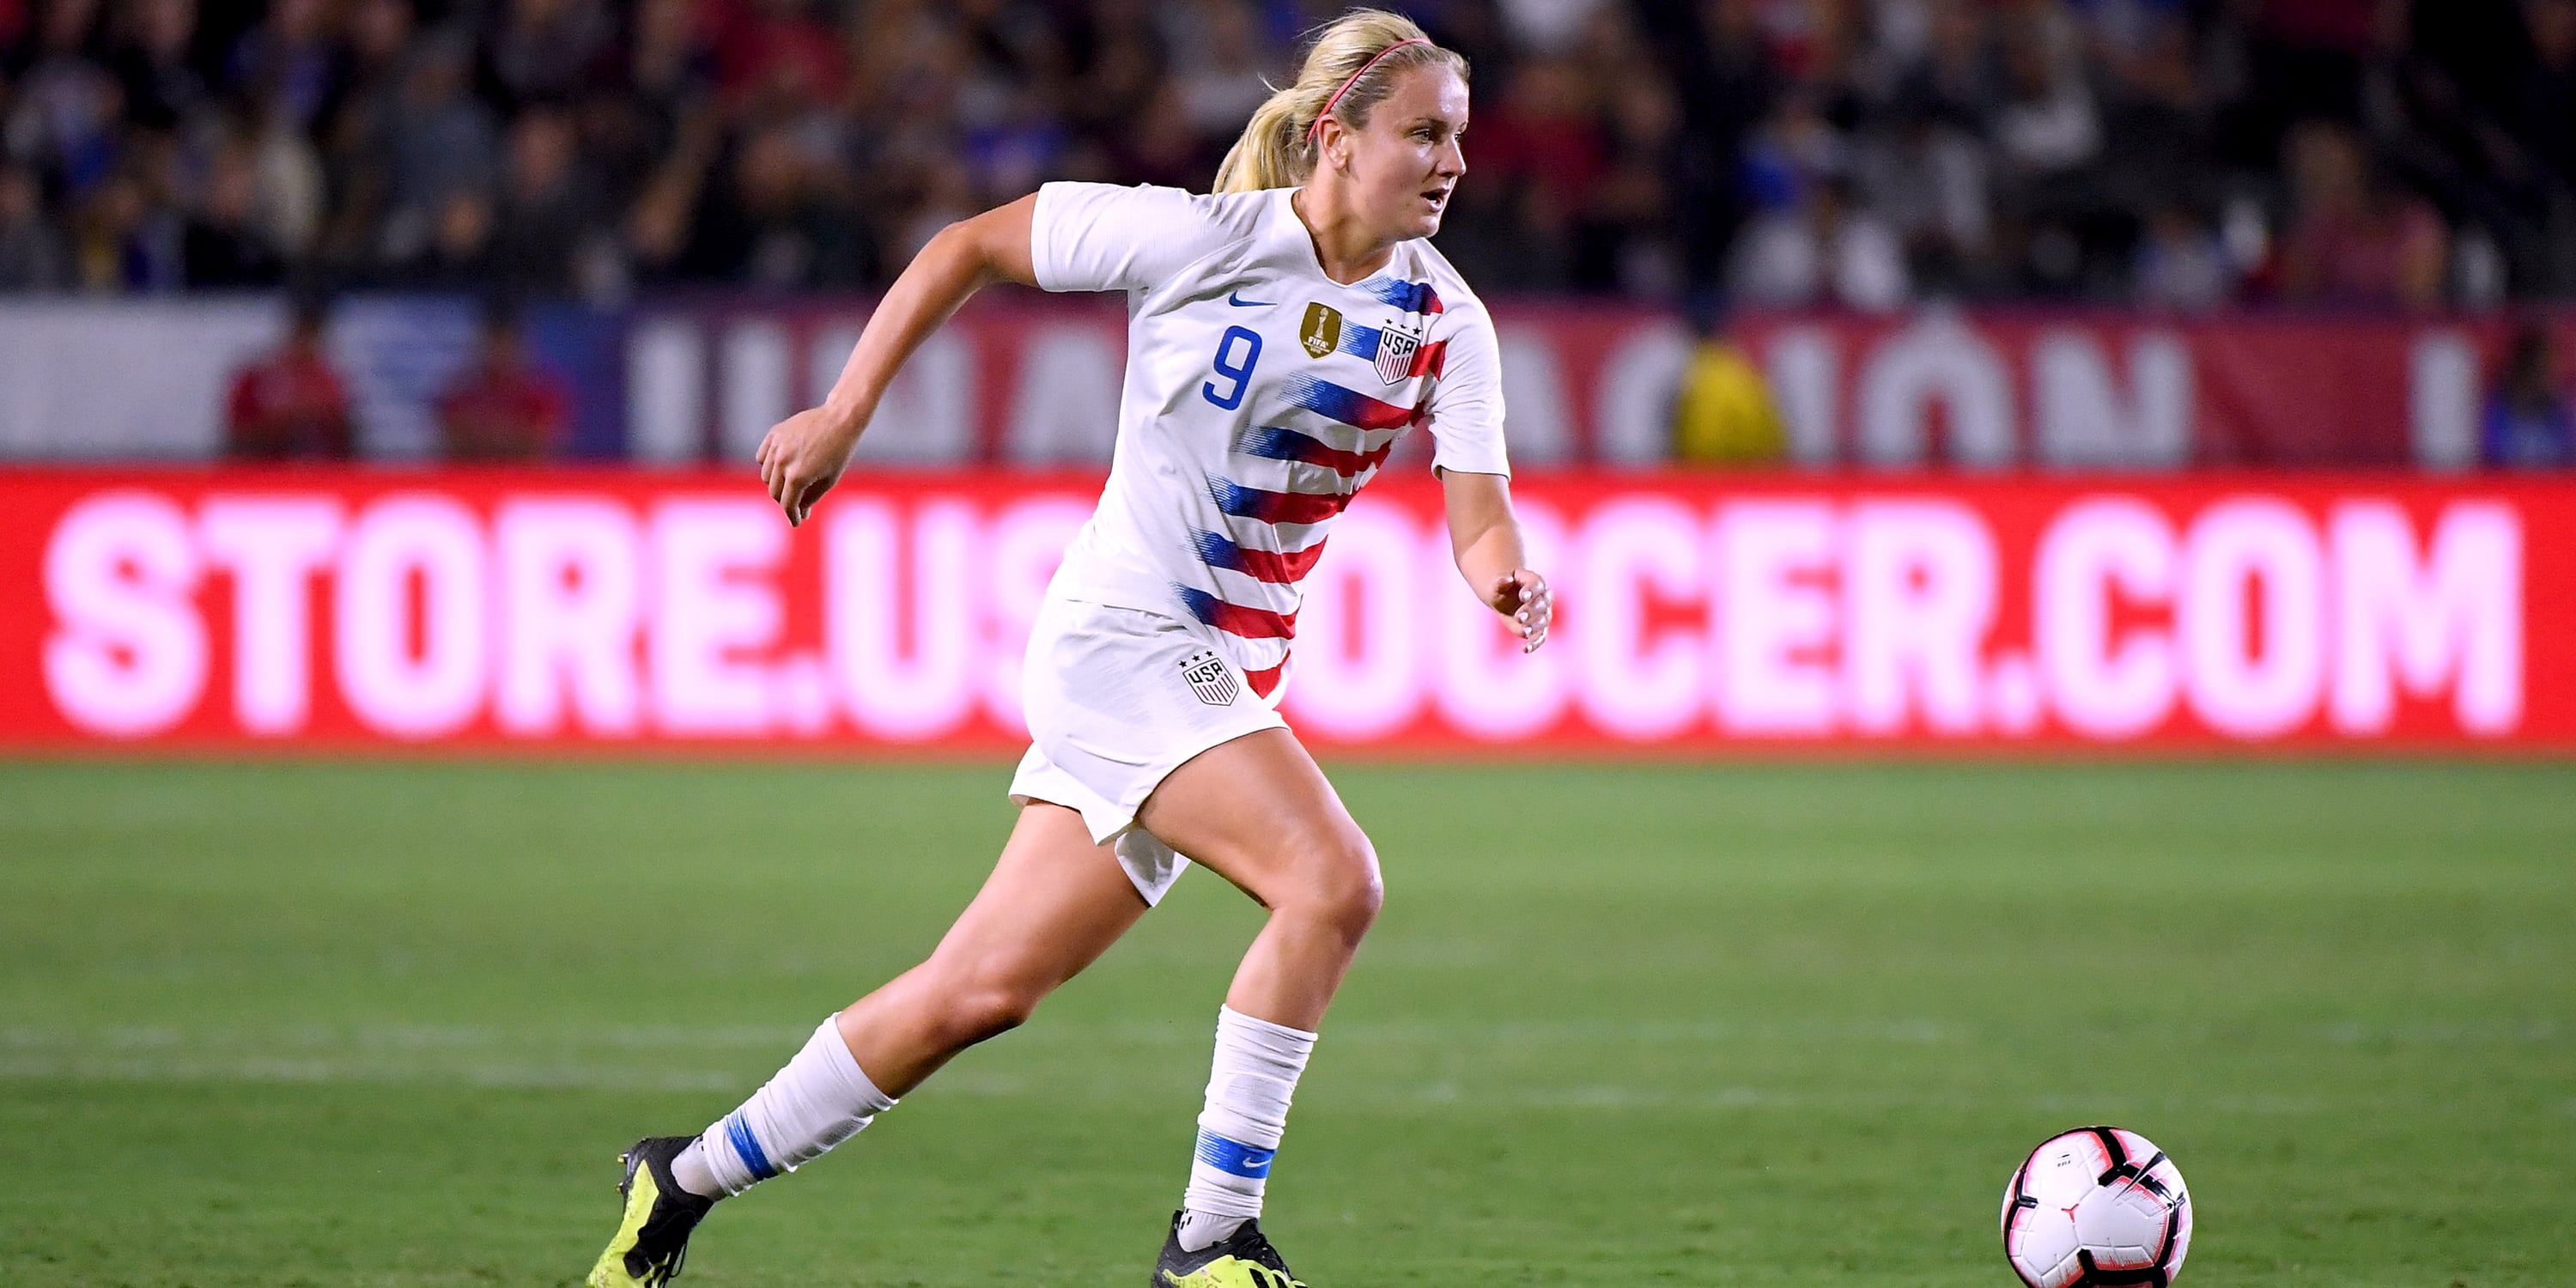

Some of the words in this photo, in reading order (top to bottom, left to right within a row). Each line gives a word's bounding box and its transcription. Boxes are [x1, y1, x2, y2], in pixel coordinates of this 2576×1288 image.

[1308, 336, 1327, 349] FIFA
[1382, 331, 1416, 355] USA
[1202, 325, 1262, 410] 9
[43, 493, 2524, 737] STORE.UOCCER.COM
[1188, 661, 1224, 683] USA
